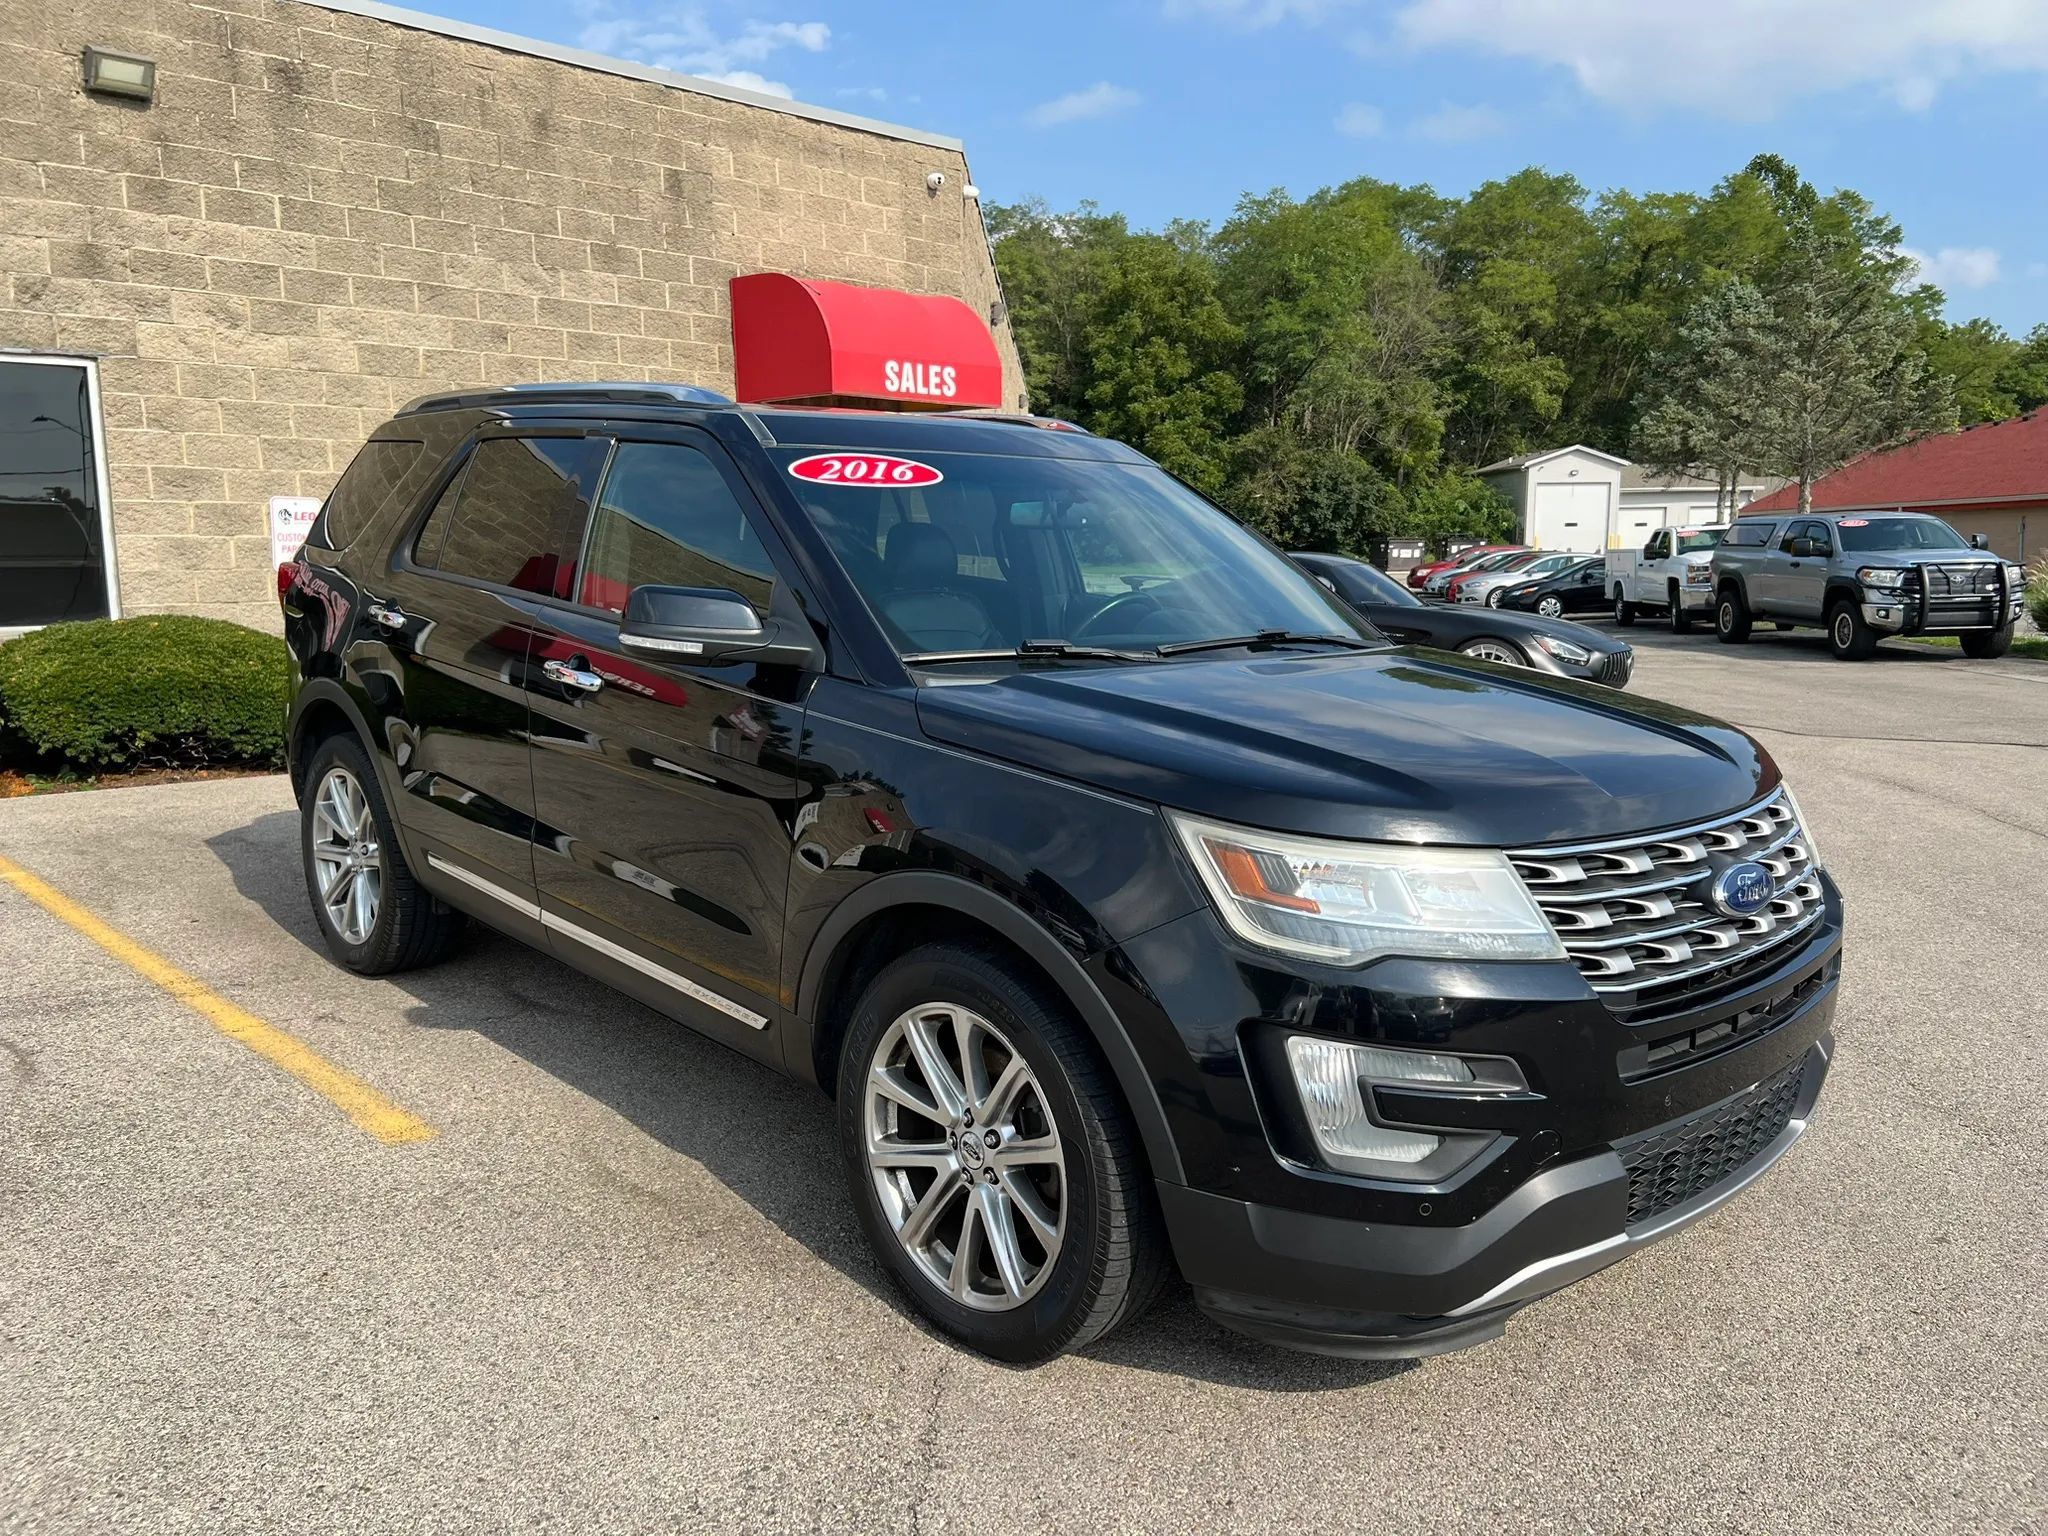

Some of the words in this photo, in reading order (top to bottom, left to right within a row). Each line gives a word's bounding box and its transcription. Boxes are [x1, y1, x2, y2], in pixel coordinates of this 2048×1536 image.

[885, 360, 957, 397] SALES
[818, 459, 915, 481] 2016
[277, 533, 306, 542] CUSTO
[1737, 871, 1769, 905] Ford
[692, 988, 760, 1024] EXPLORER
